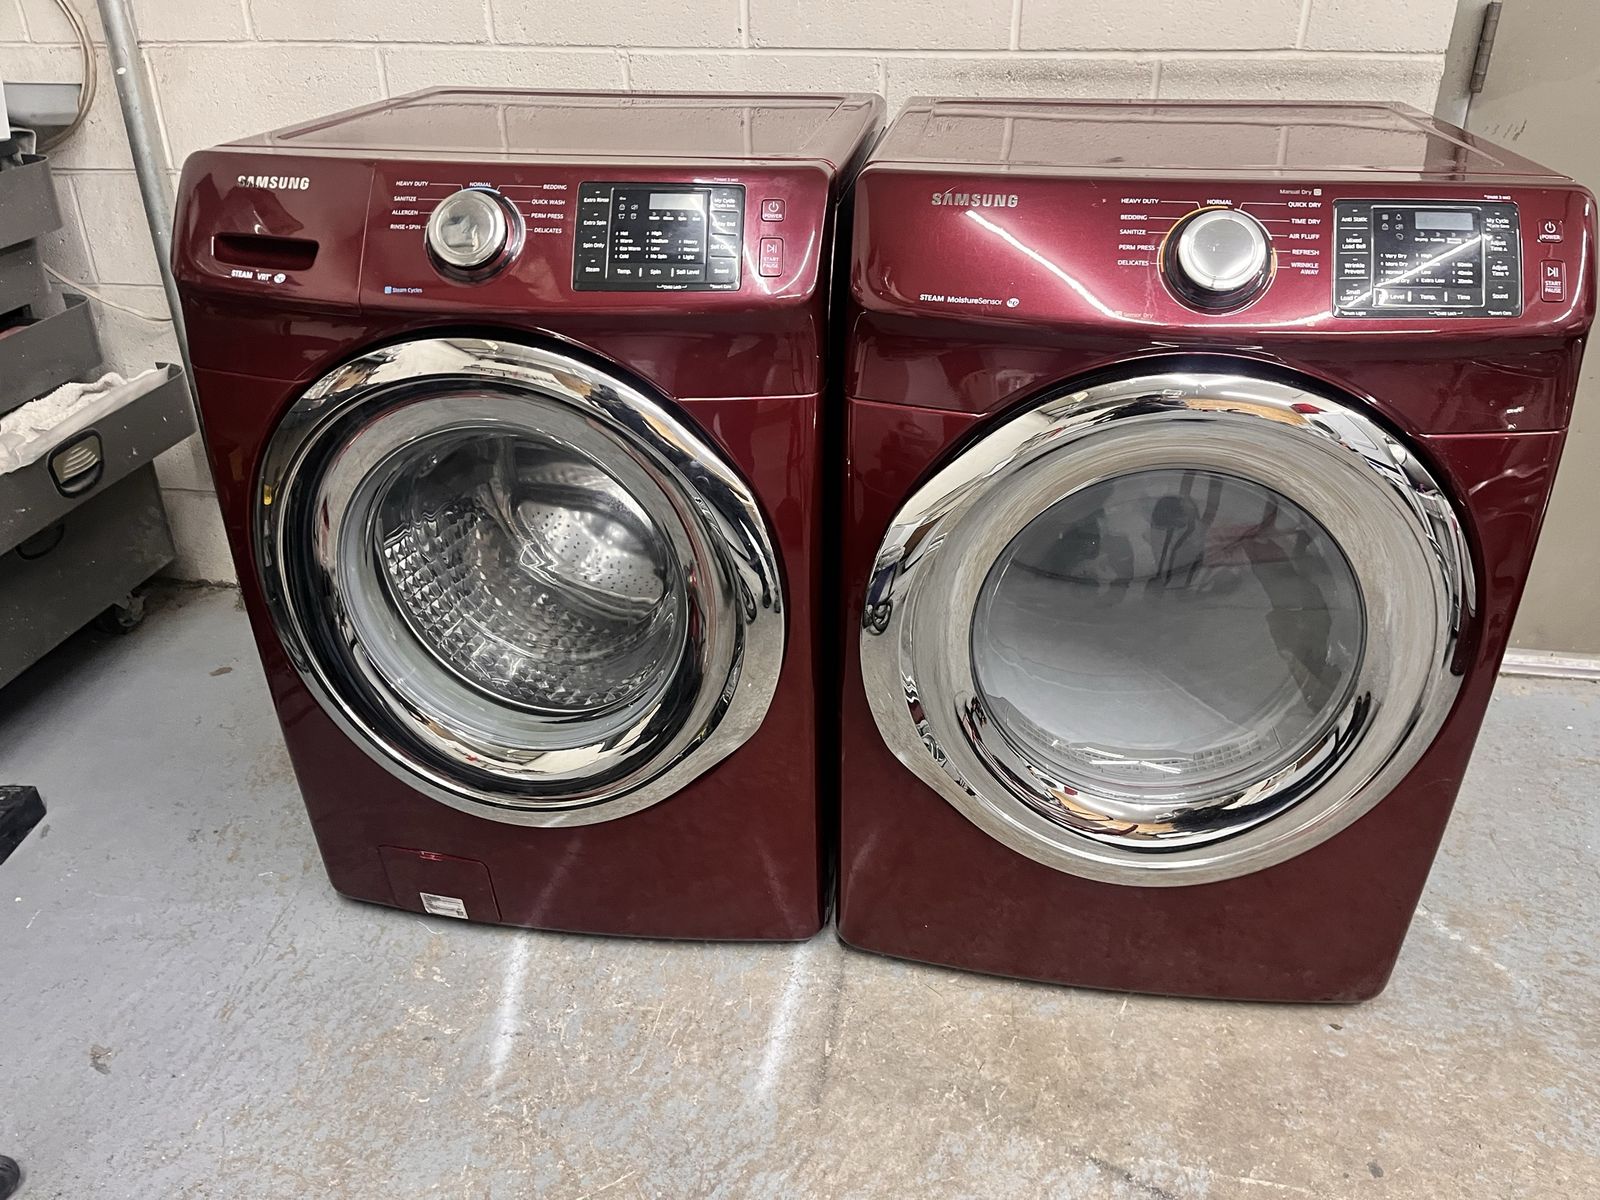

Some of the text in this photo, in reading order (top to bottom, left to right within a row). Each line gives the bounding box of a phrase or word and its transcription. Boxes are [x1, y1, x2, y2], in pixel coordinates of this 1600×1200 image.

[238, 176, 310, 190] SAMSUNG
[932, 193, 1018, 207] SAMSUNG
[231, 270, 252, 279] STEAM
[947, 296, 1002, 305] MoistureSensor
